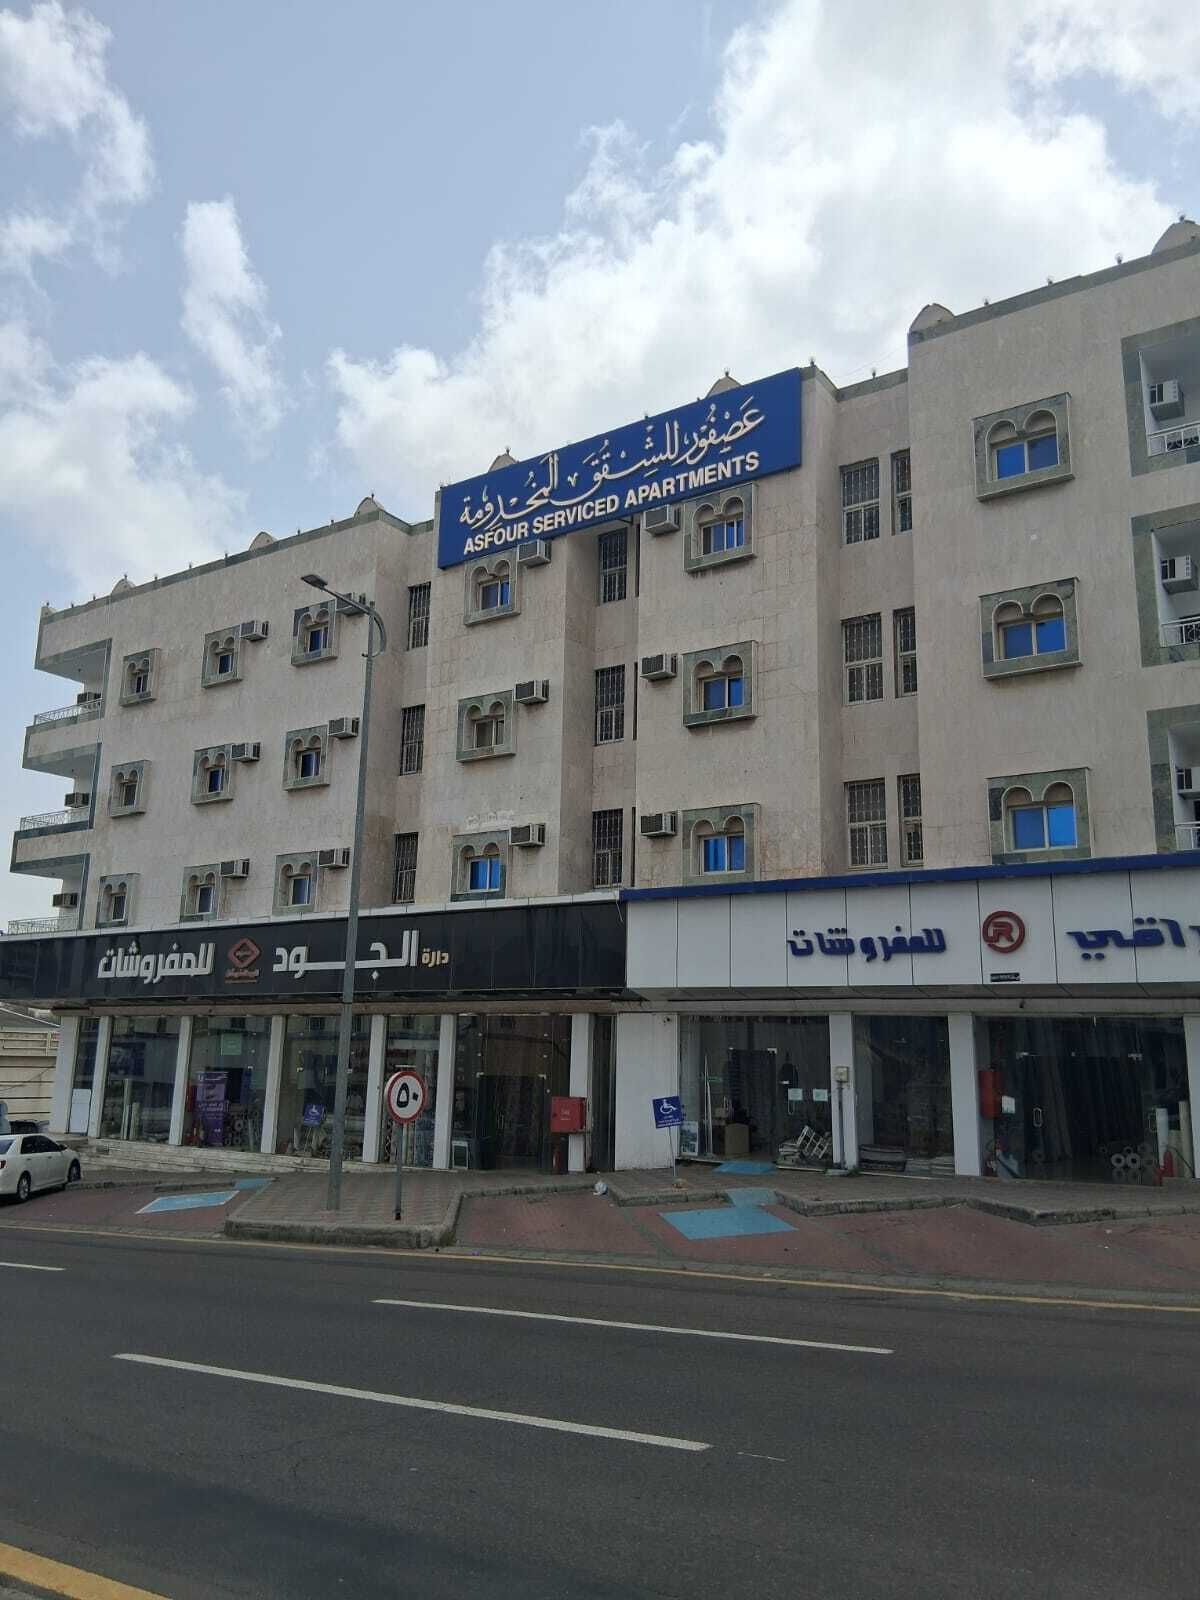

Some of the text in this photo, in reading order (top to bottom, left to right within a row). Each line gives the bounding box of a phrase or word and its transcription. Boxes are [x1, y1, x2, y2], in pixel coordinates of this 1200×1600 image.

[463, 451, 760, 555] ASFOUR SERVICED APARTMENTS
[97, 930, 449, 984] دارة الجود للمفروشات
[787, 925, 947, 963] للمفروشات
[396, 1083, 419, 1108] ٥٠
